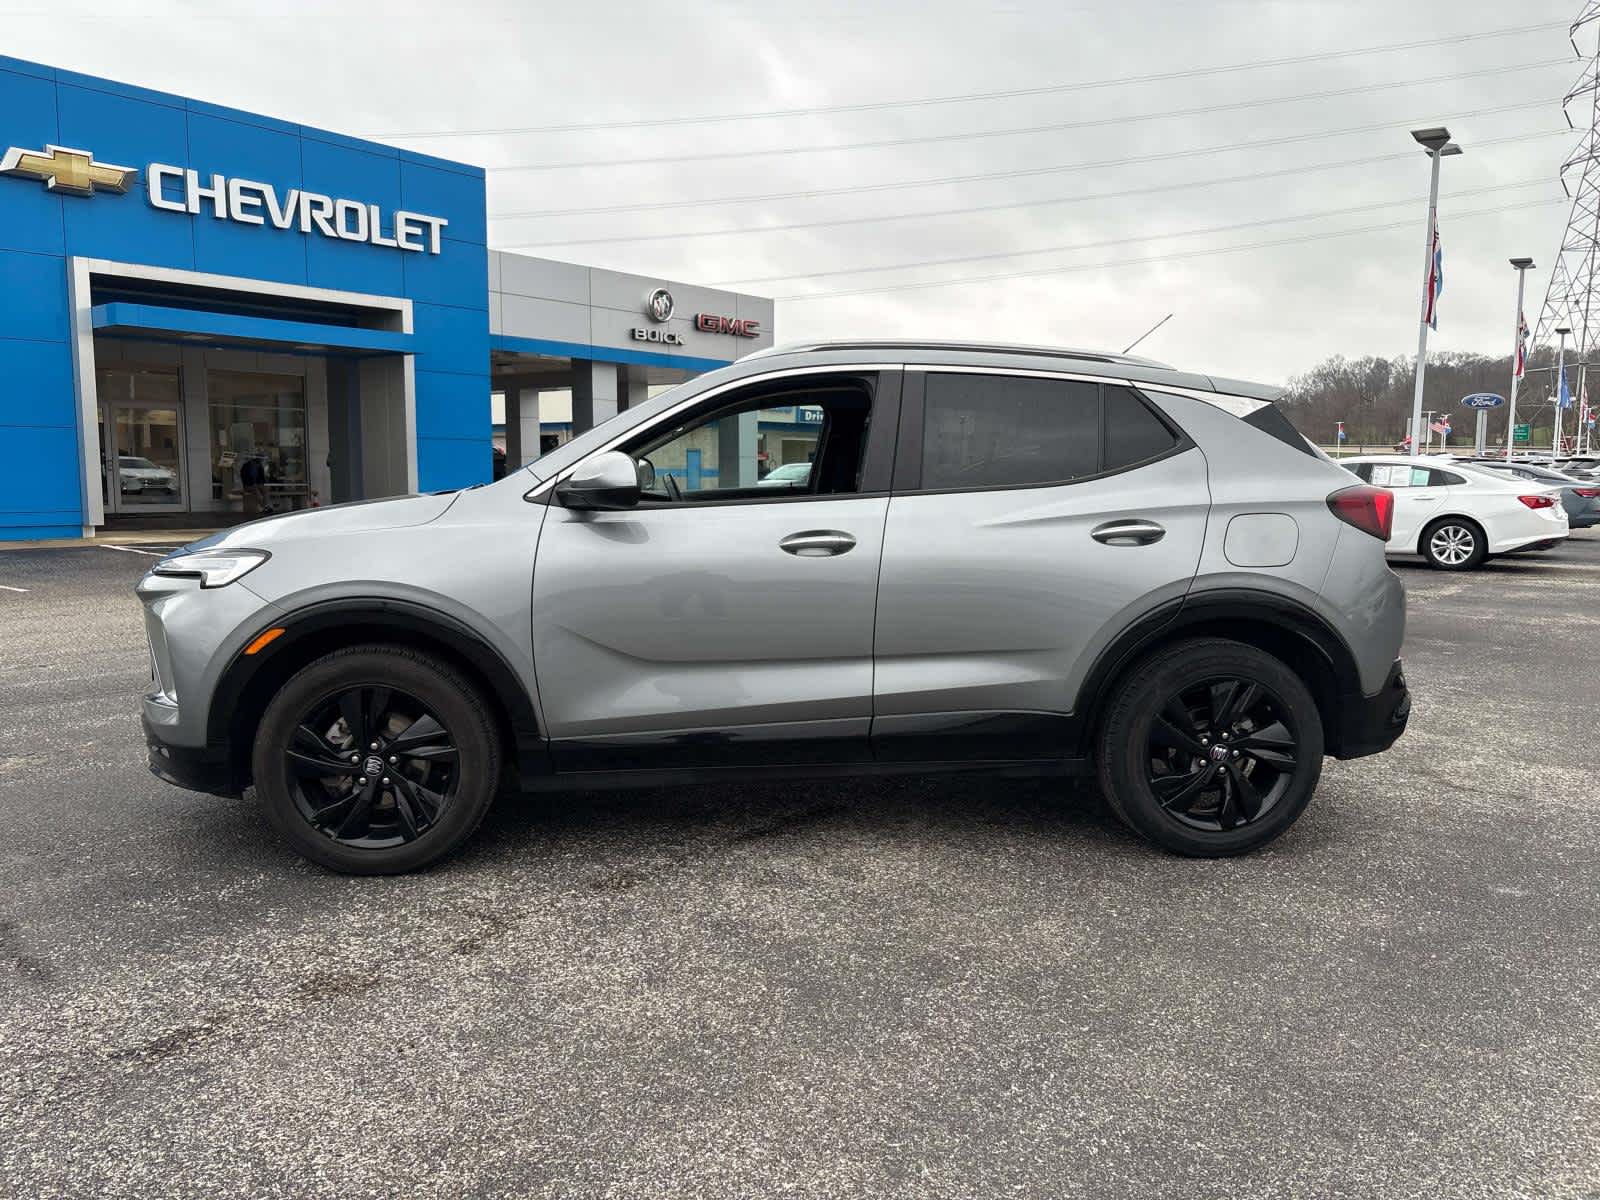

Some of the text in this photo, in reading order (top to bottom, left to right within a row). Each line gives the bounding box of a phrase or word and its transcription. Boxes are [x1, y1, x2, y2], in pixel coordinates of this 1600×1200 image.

[147, 163, 448, 255] CHEVROLET
[697, 313, 760, 338] GMC
[634, 328, 686, 345] BUICK
[1471, 396, 1497, 406] Ford
